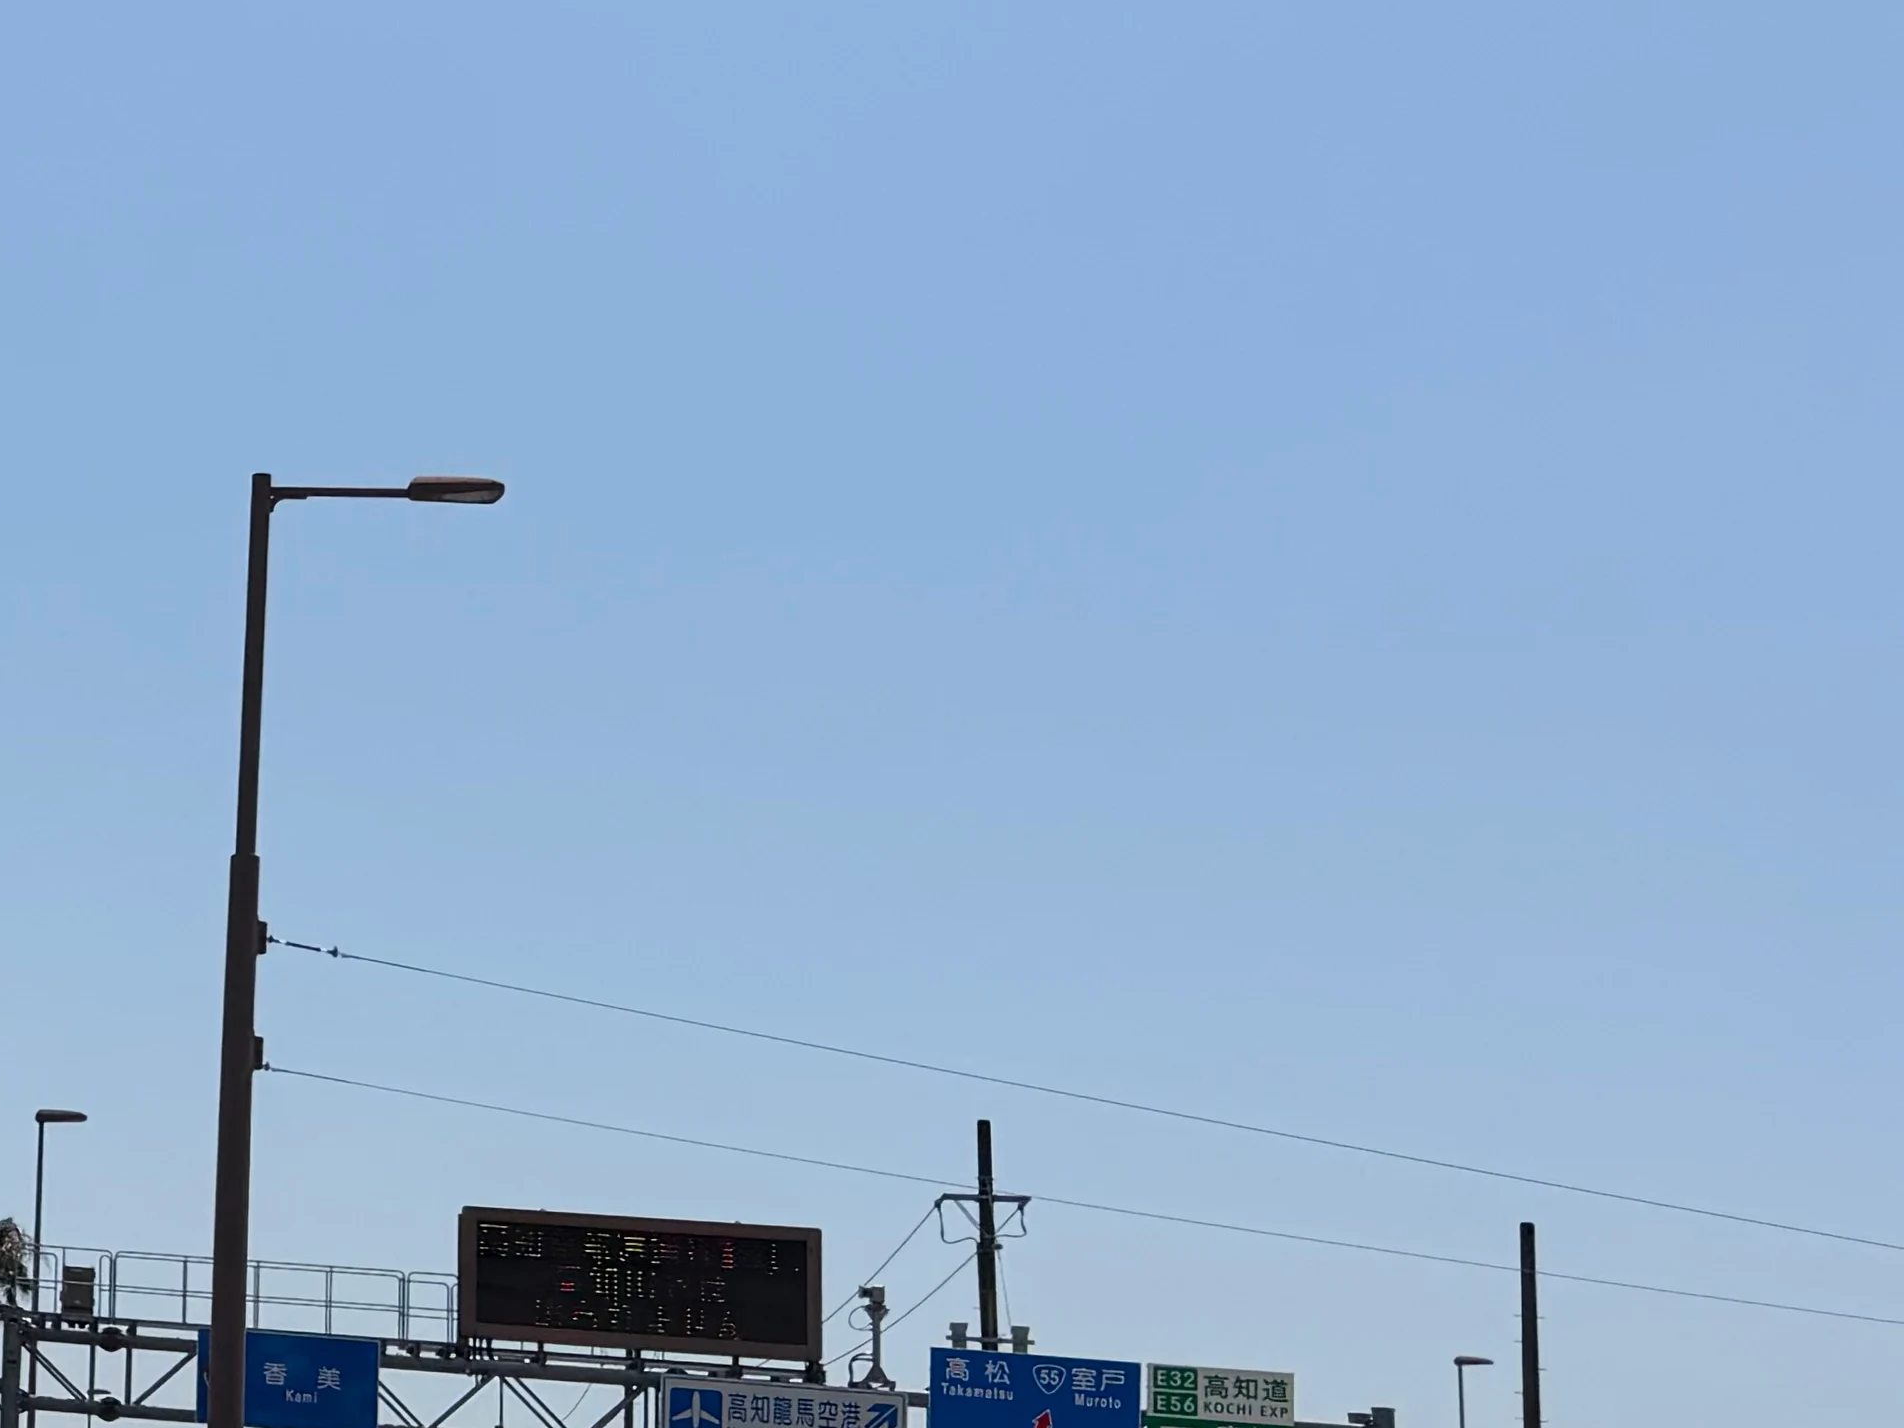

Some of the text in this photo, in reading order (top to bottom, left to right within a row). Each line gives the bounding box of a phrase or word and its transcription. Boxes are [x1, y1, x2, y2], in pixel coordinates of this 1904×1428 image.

[945, 1357, 1011, 1384] 高松
[1040, 1369, 1059, 1385] 55
[1071, 1367, 1126, 1392] 室戸
[1156, 1369, 1195, 1388] E32
[285, 1389, 318, 1404] Kami
[941, 1382, 1014, 1401] Takamatsu
[1203, 1374, 1289, 1403] 高知道
[1074, 1393, 1122, 1409] Muroto
[1156, 1395, 1195, 1413] E56
[1203, 1402, 1289, 1419] KOCHI EXP
